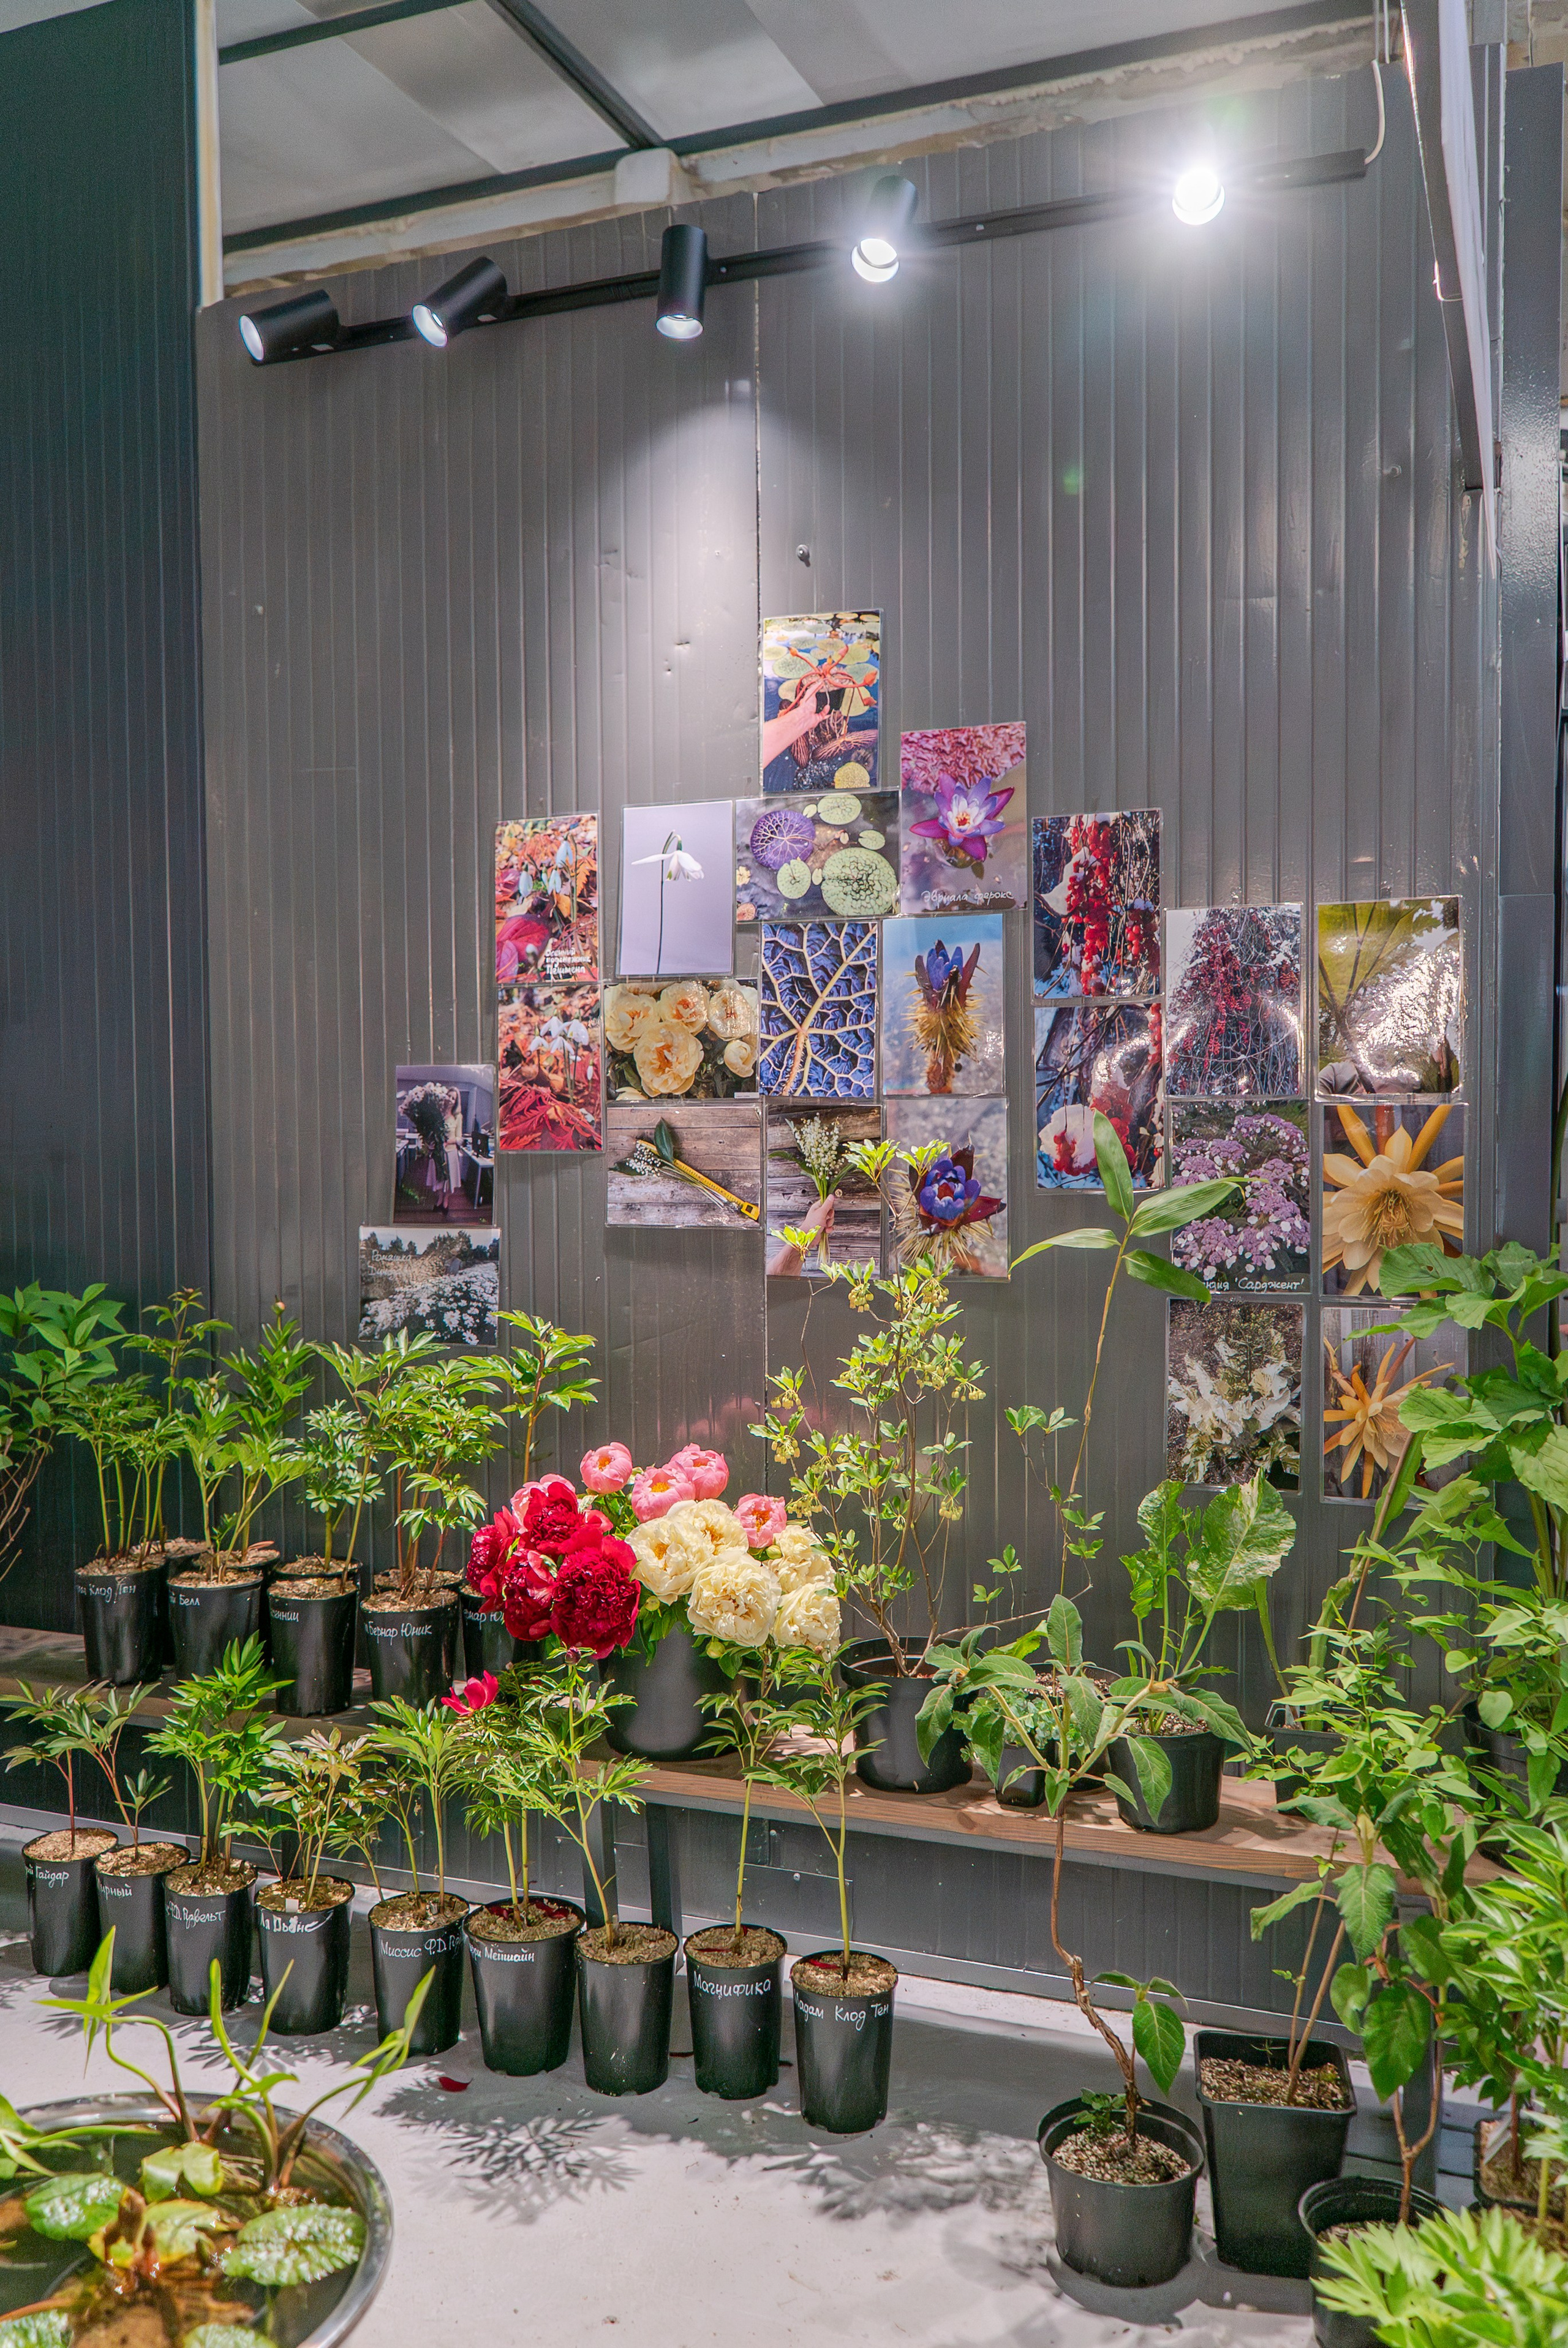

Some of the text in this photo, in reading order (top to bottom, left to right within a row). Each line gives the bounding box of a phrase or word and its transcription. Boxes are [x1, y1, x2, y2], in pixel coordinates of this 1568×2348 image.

[921, 890, 968, 909] Эвриала
[179, 1594, 200, 1606] Белл
[369, 1621, 398, 1646] Бернар
[401, 1622, 432, 1637] Юник
[36, 1865, 69, 1888] Гайдар
[694, 1971, 771, 1997] Магнифика
[835, 2005, 866, 2031] Клод
[870, 2003, 889, 2018] Тен
